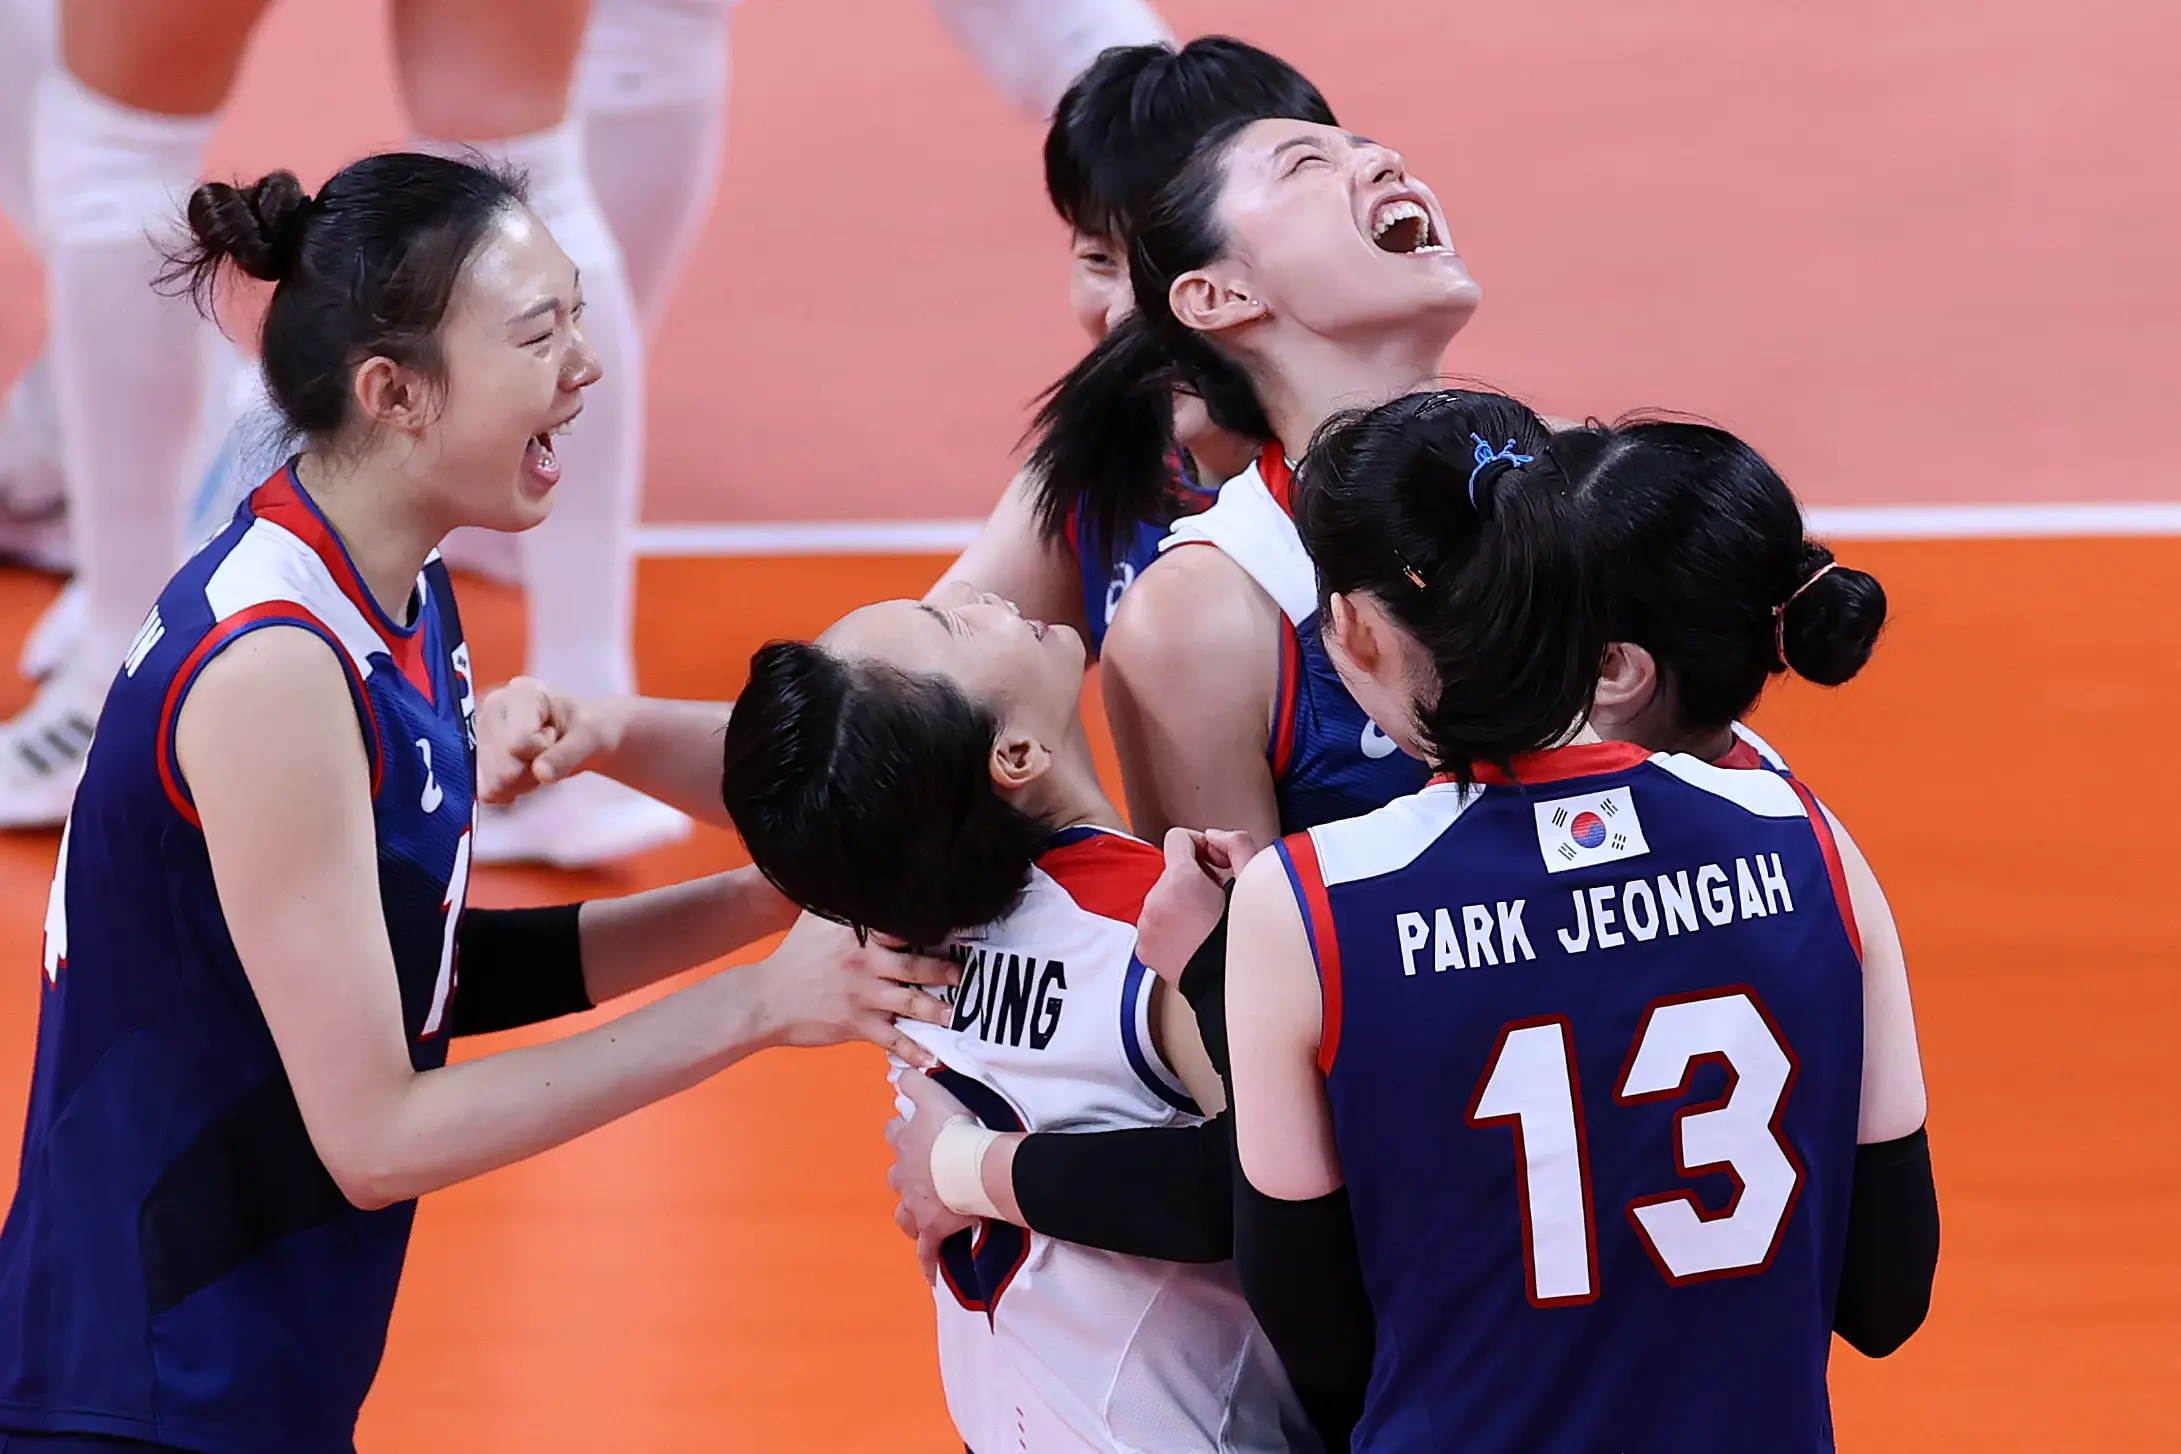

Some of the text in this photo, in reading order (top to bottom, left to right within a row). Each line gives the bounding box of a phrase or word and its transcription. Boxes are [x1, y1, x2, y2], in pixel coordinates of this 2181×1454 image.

[1396, 852, 1794, 976] PARK JEONGAH
[1465, 983, 1805, 1307] 13
